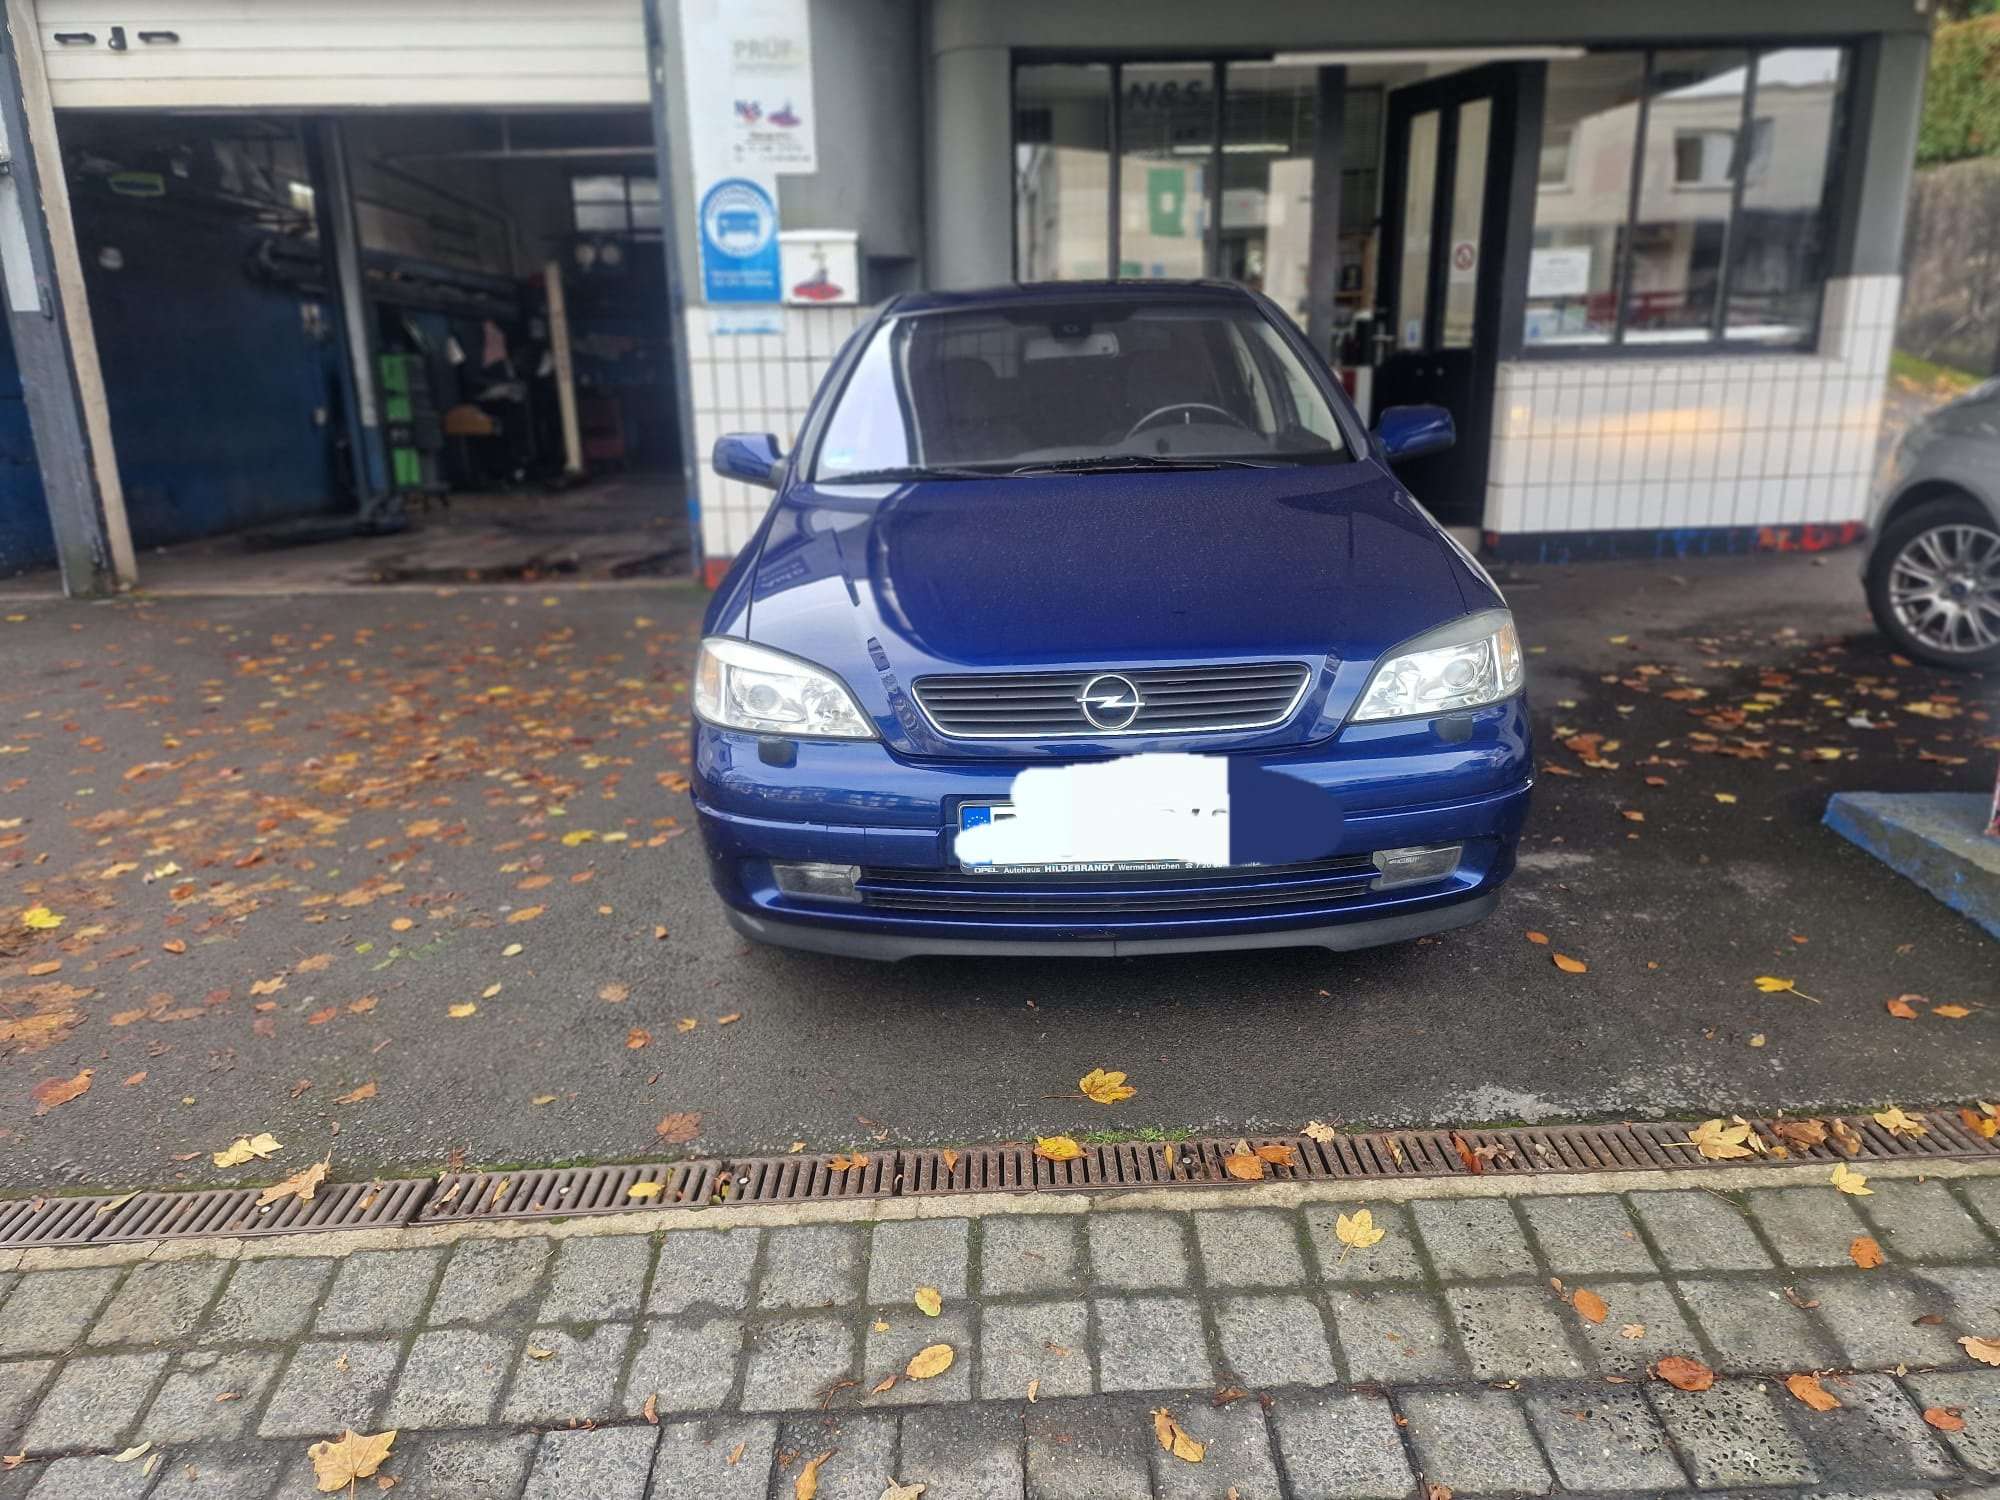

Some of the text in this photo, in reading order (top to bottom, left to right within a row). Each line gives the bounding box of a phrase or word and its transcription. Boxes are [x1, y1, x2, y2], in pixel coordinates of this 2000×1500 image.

[1003, 866, 1041, 874] Autohaus
[1044, 863, 1115, 873] HILDEBRANDT
[1117, 863, 1181, 871] Wermelskirchen
